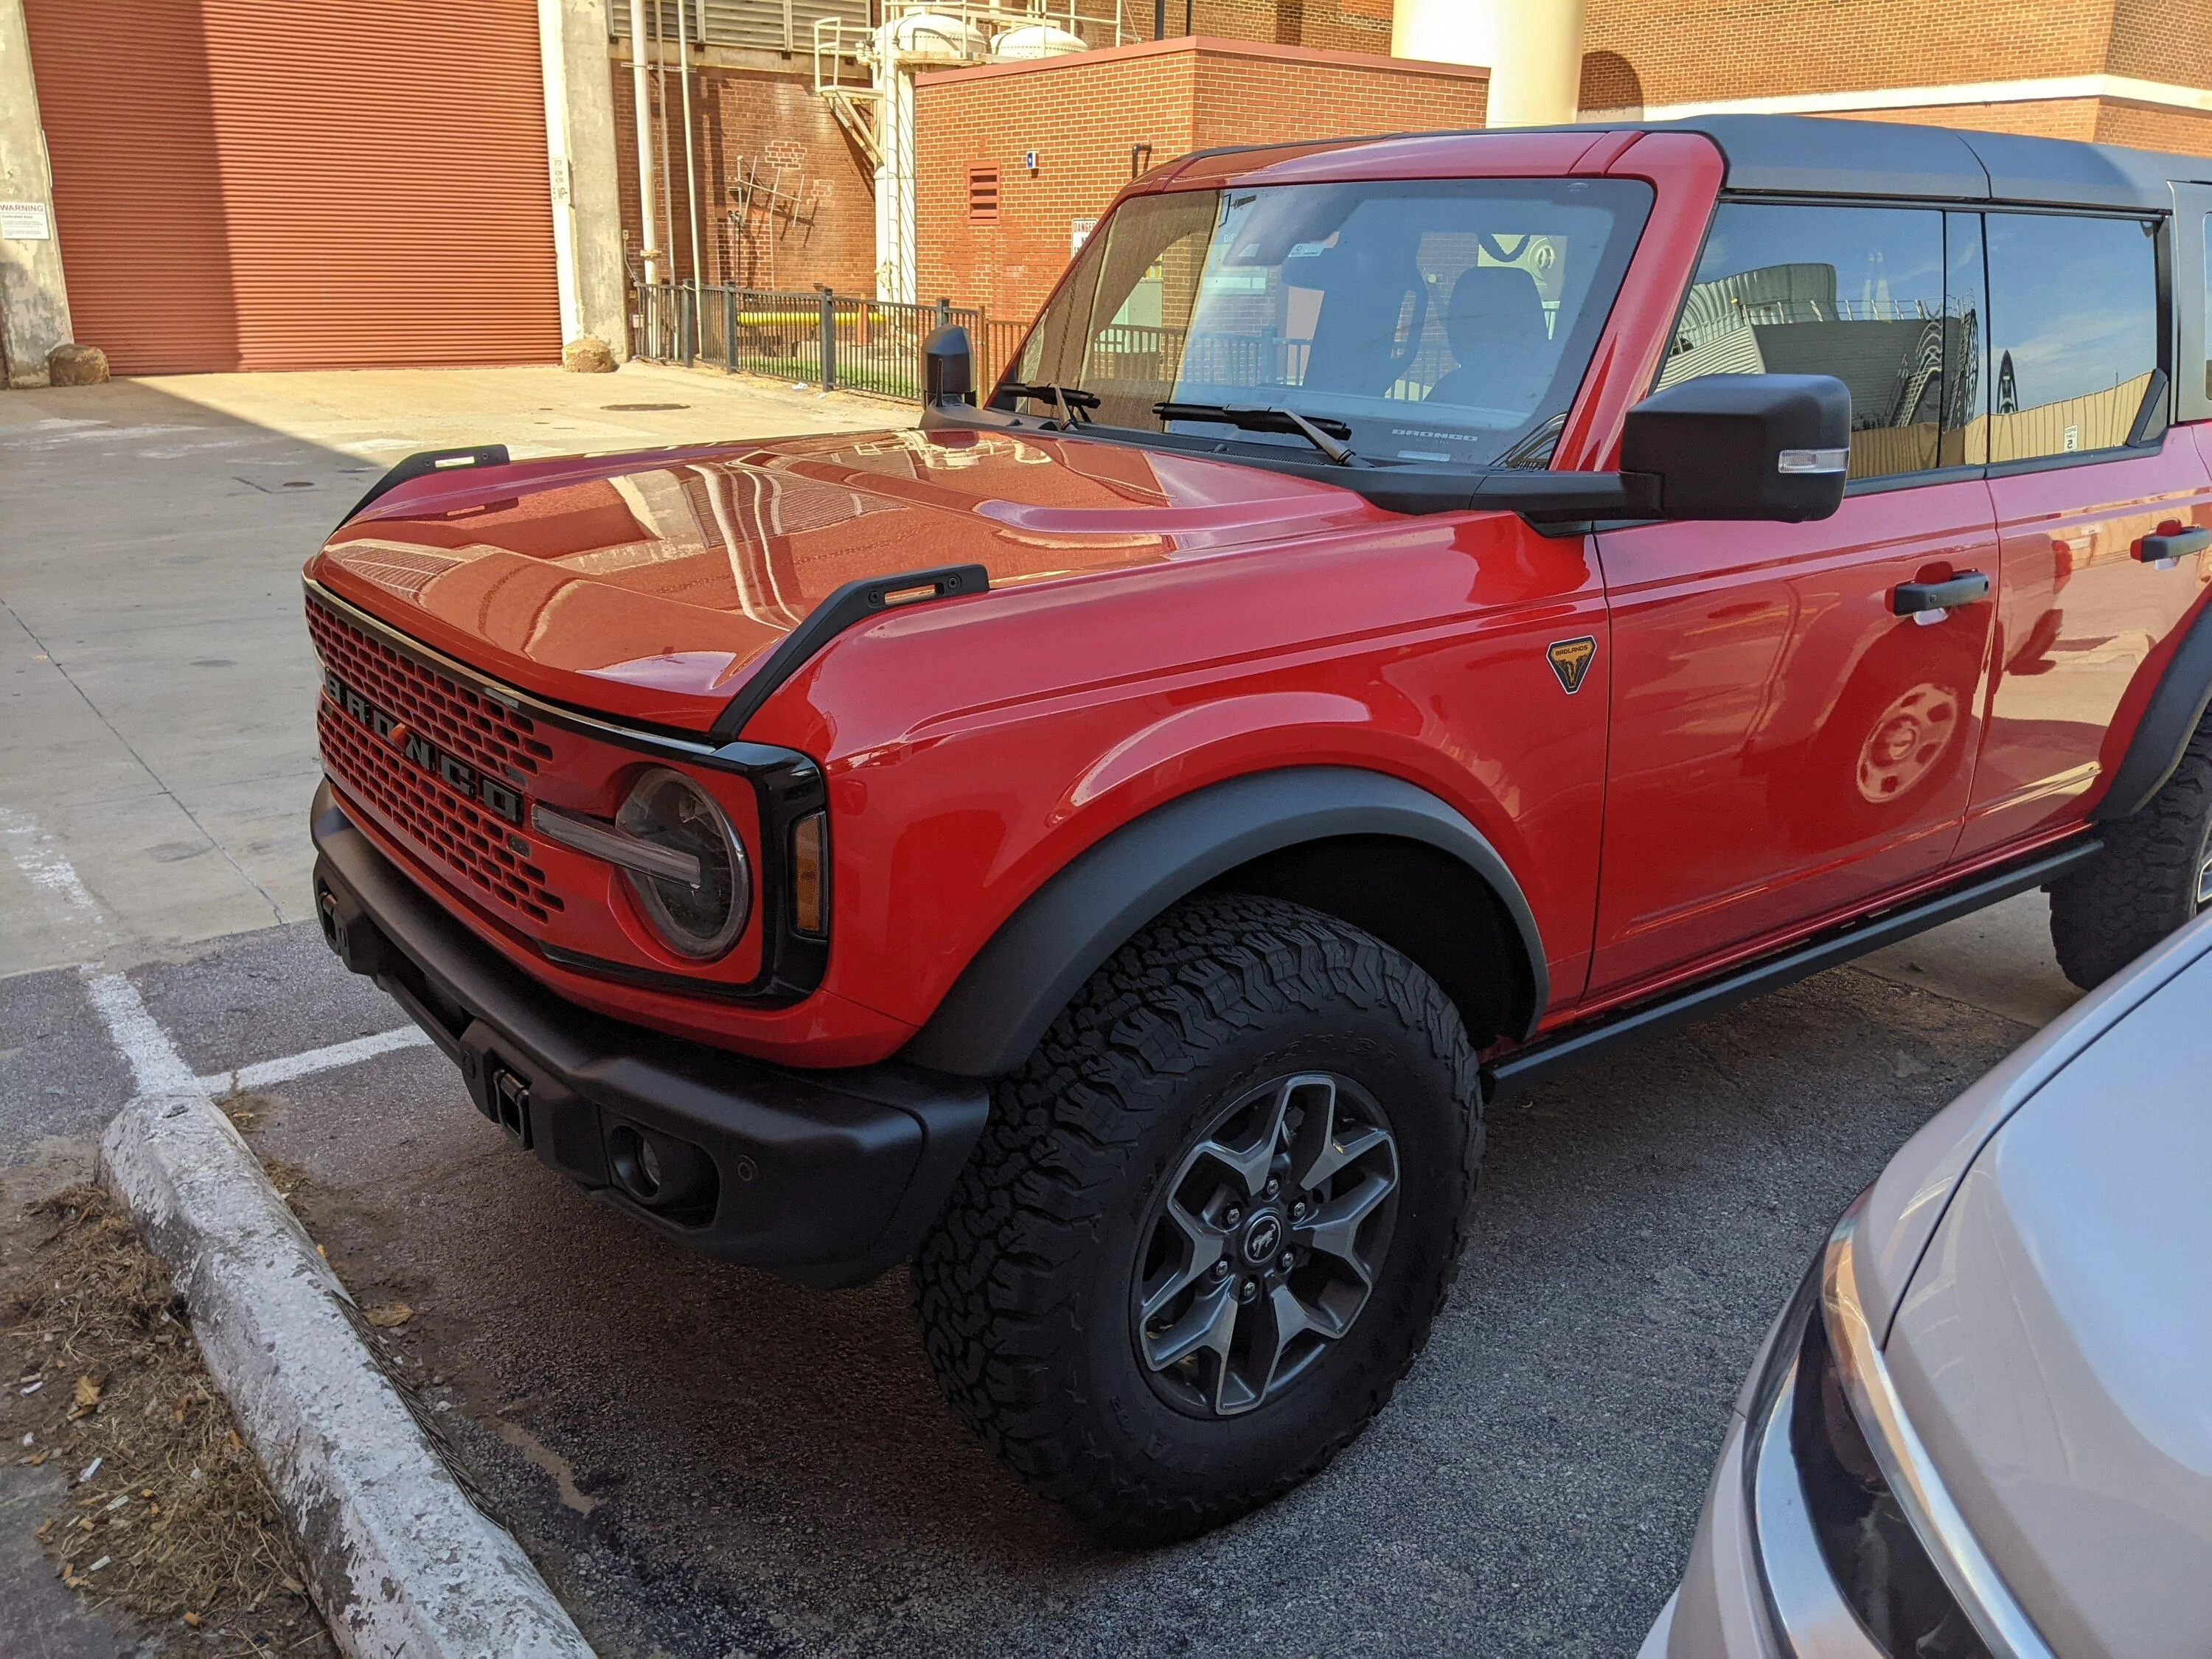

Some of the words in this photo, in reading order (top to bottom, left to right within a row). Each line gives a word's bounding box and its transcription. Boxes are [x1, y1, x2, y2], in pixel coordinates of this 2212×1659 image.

[1392, 428, 1478, 442] BRONCO
[1555, 644, 1588, 656] BADLANDS
[325, 675, 524, 823] BRONCO
